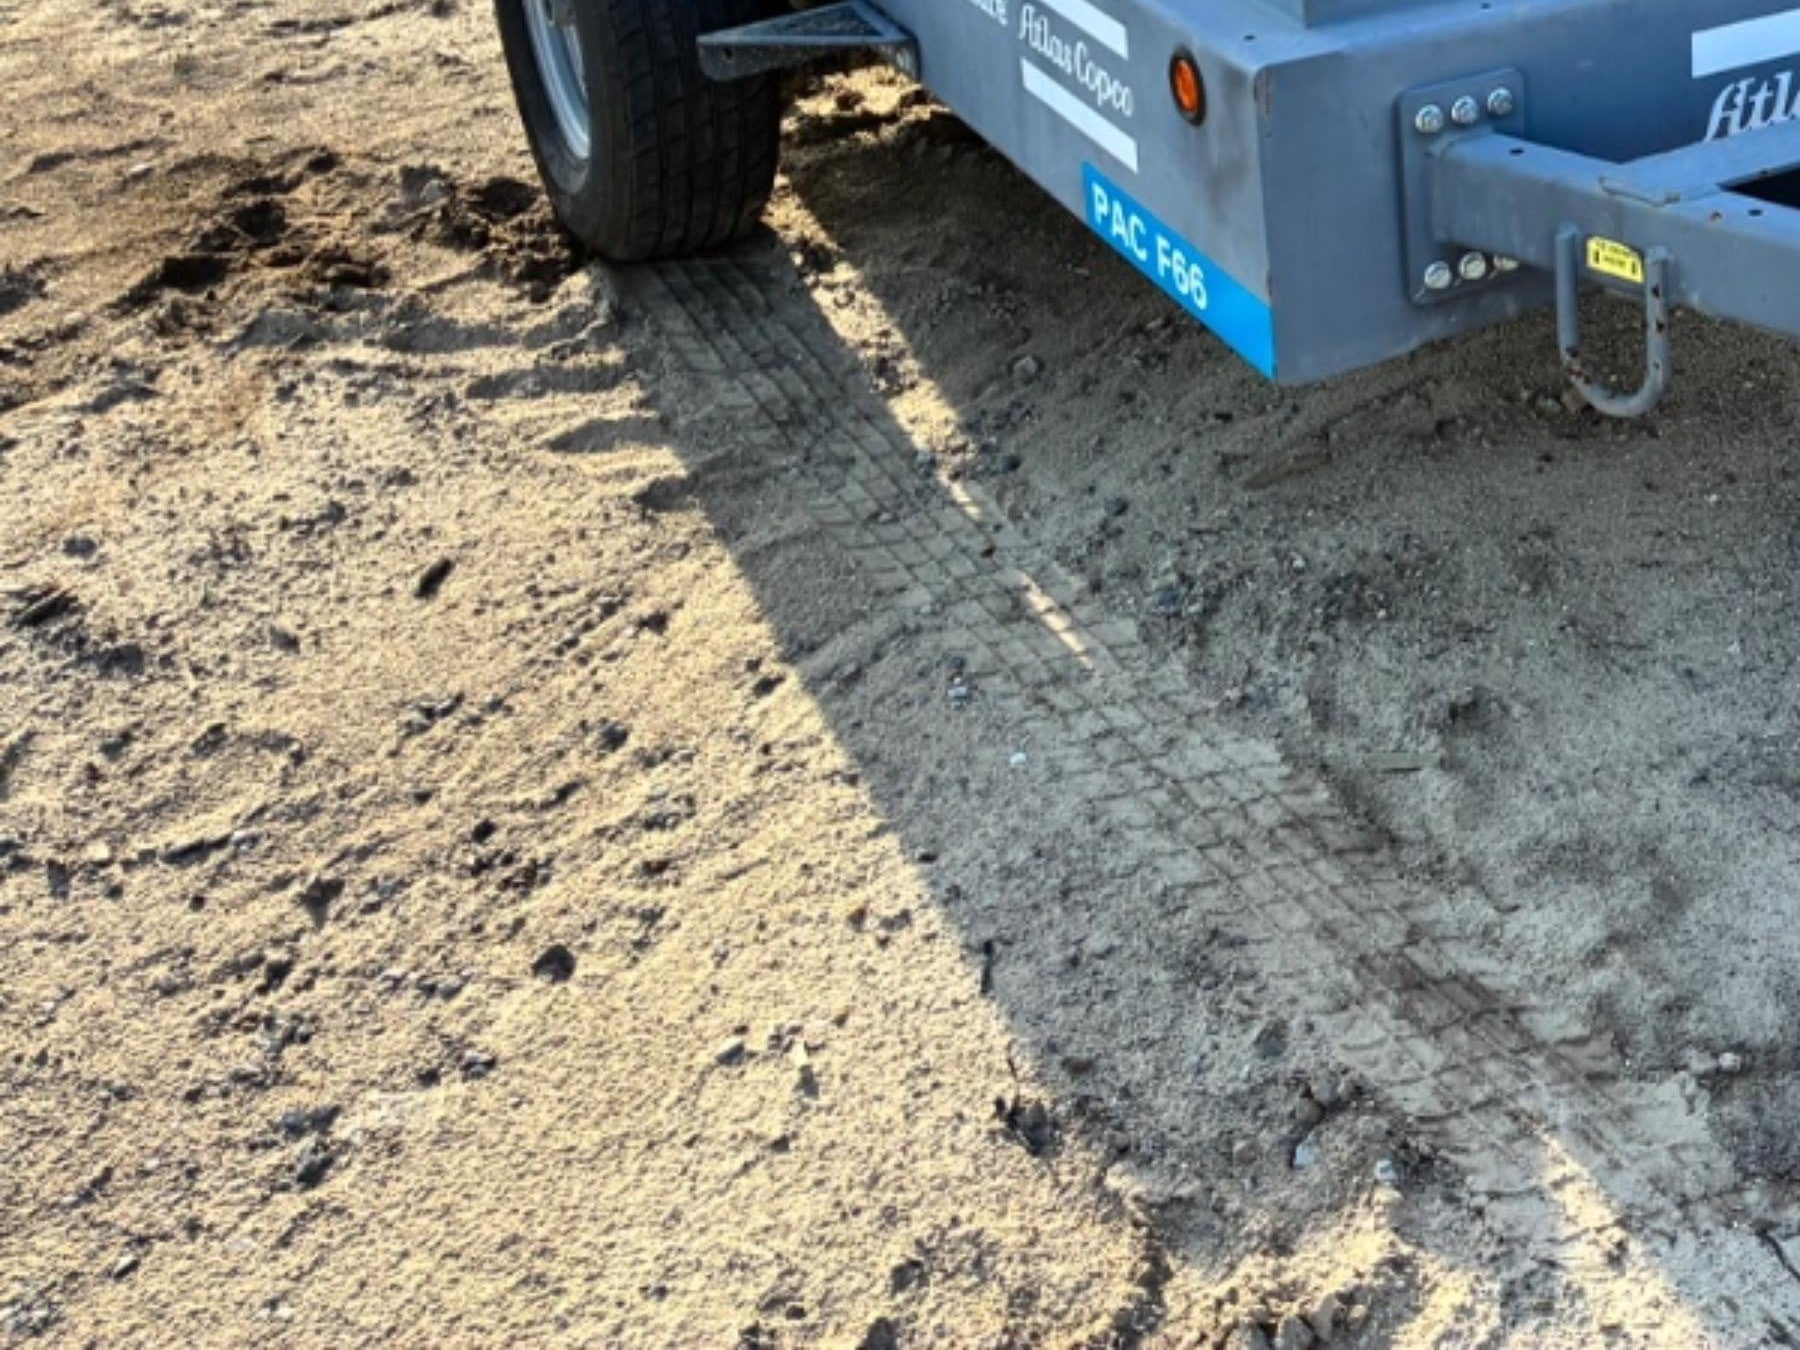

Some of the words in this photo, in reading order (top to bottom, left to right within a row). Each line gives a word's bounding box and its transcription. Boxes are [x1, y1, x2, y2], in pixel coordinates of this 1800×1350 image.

[1018, 3, 1072, 75] Atlas
[1073, 40, 1133, 118] Copco
[1091, 181, 1148, 263] PAC
[1155, 233, 1208, 311] F66
